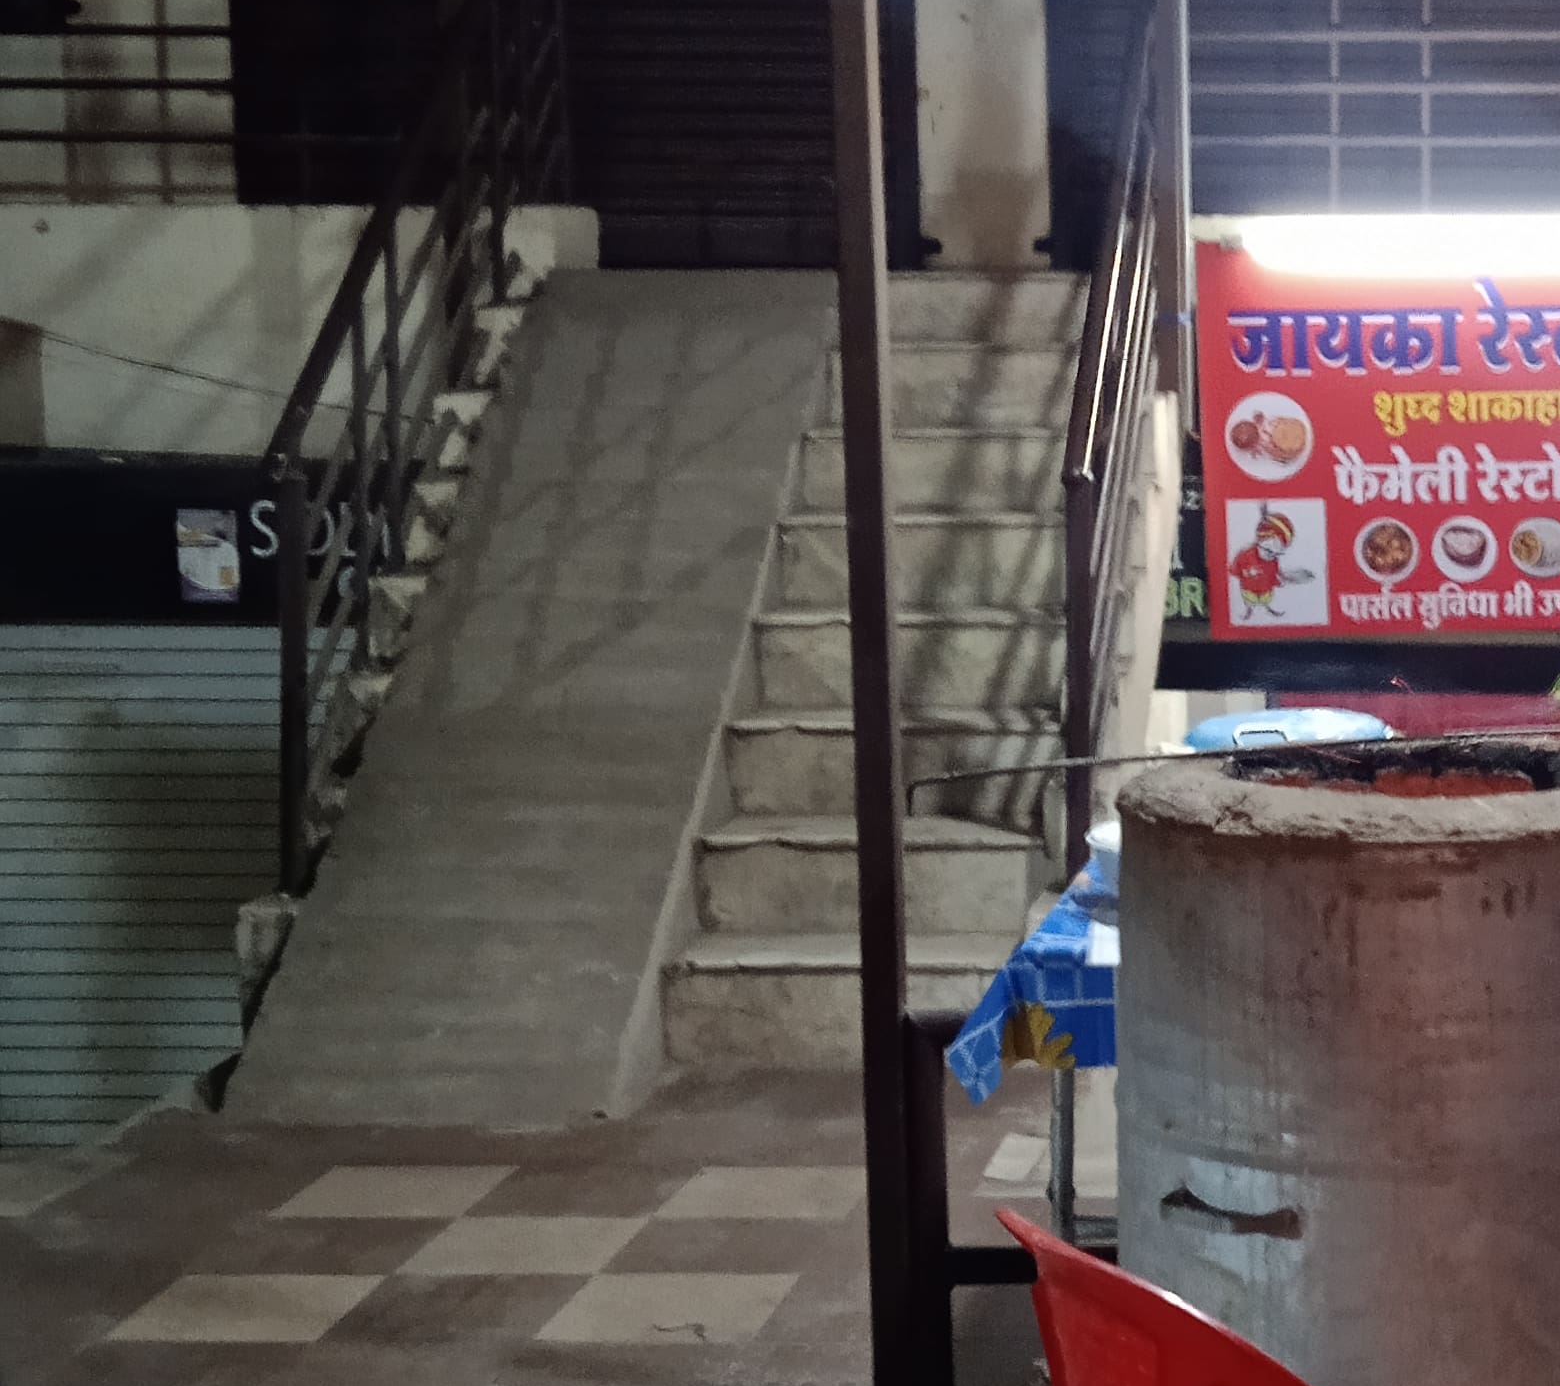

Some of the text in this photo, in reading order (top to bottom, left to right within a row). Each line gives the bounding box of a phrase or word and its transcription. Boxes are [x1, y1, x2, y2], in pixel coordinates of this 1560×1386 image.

[1226, 307, 1463, 377] जायका
[1416, 582, 1498, 630] सुविधा
[1502, 581, 1534, 618] भी
